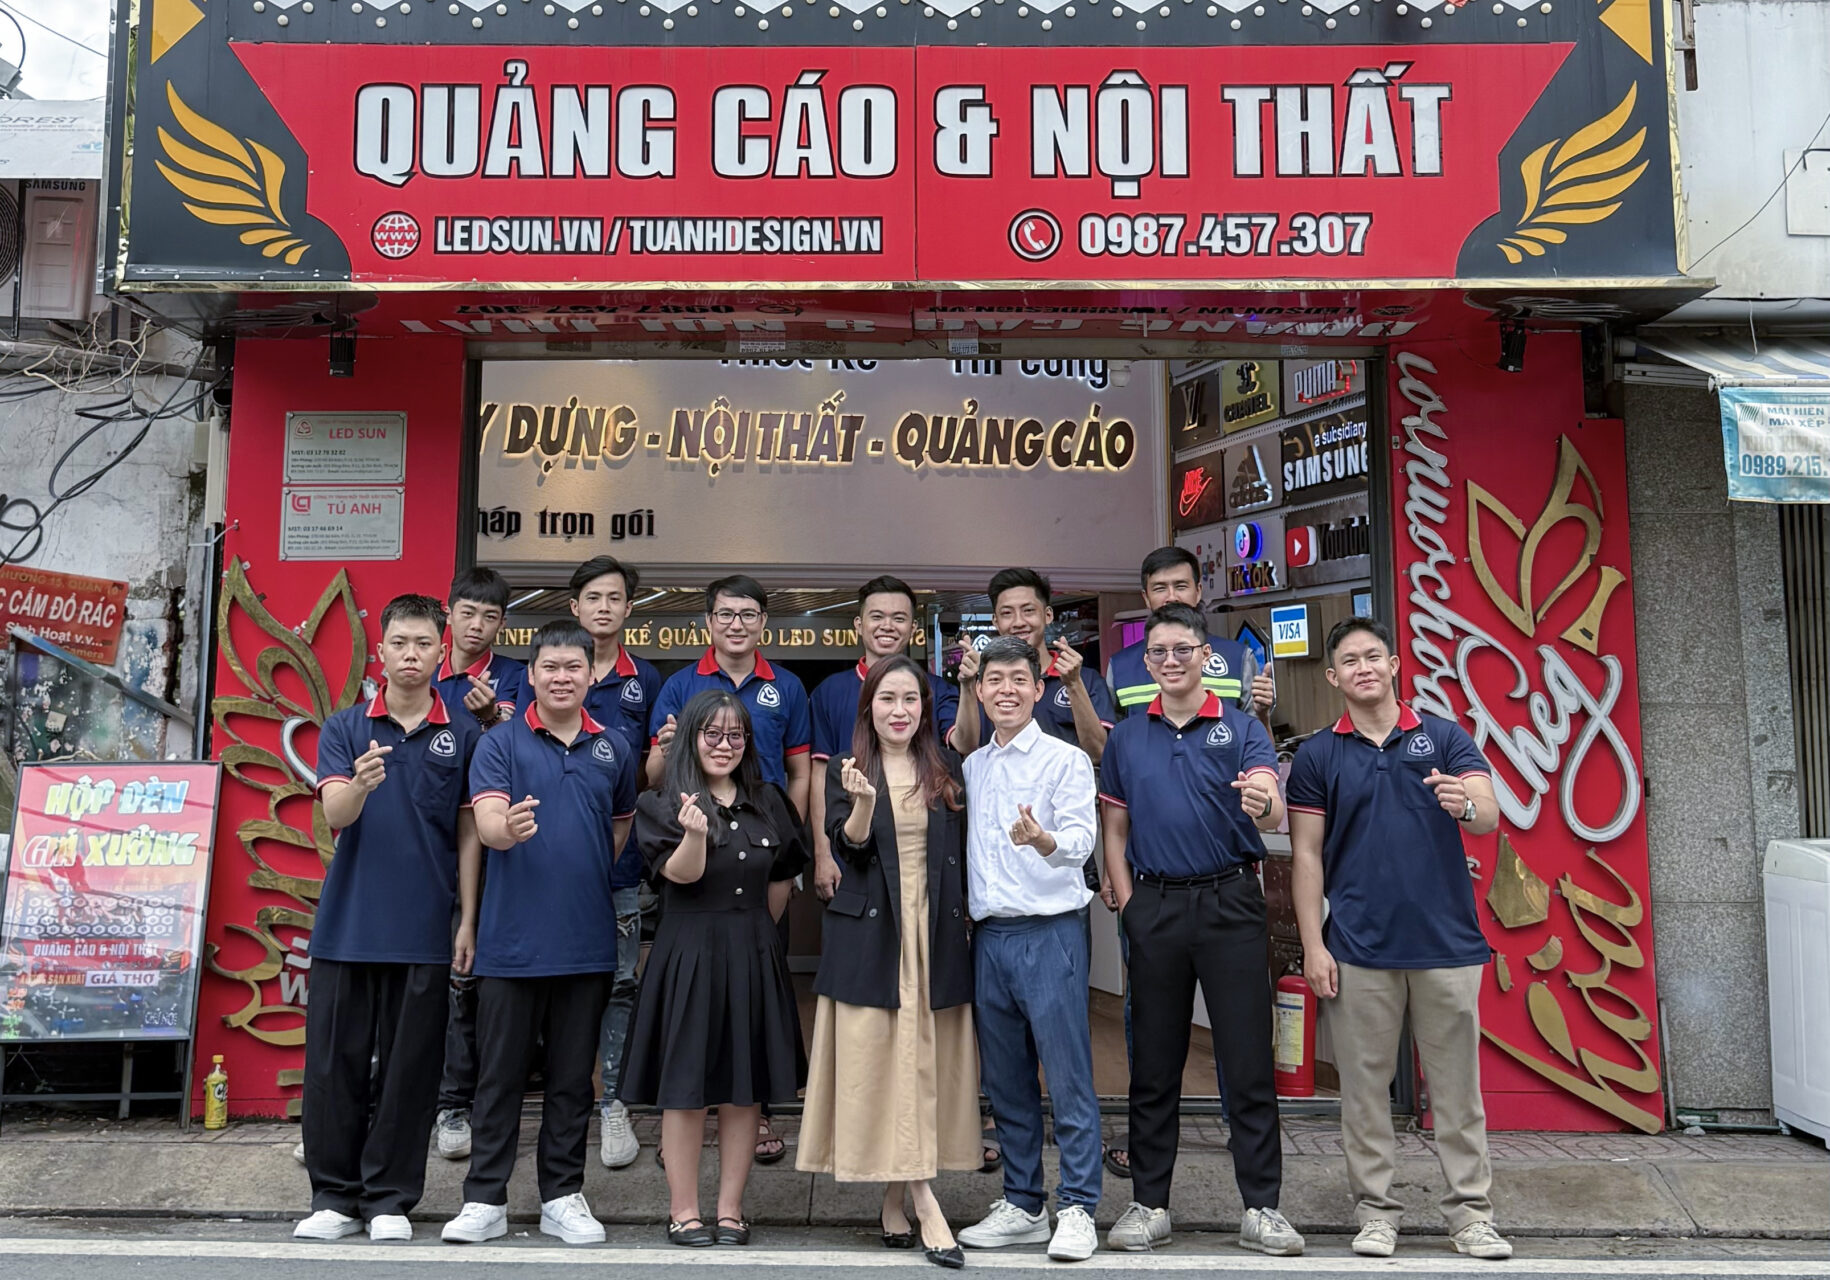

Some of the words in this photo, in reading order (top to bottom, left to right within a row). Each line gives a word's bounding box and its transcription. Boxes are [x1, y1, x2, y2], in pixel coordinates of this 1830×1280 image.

[354, 58, 677, 188] QUẢNG
[711, 68, 898, 180] CÁO
[933, 84, 999, 179] &
[1030, 68, 1190, 200] NỘI
[1221, 61, 1452, 178] THẤT
[25, 180, 86, 192] SAMSUNG
[434, 216, 602, 255] LEDSUN.VN
[626, 216, 884, 255] TUANHDESIGN.VN
[1078, 213, 1373, 256] 0987.457.307
[329, 428, 354, 439] LED
[358, 428, 387, 439] SUN
[504, 395, 638, 474] DỰNG
[666, 396, 751, 476] NỘI
[756, 390, 865, 463] THẤT
[895, 399, 1045, 470] QUẢNG
[1049, 403, 1135, 471] CÁO
[350, 503, 382, 514] ANH
[539, 506, 594, 542] trọn
[611, 509, 655, 540] gói
[78, 596, 116, 628] RÁC
[625, 619, 652, 646] KẾ
[658, 621, 711, 650] QUẢN
[779, 629, 816, 646] LED
[822, 629, 860, 646] SUN
[1278, 622, 1302, 640] VISA
[44, 774, 117, 822] HỘP
